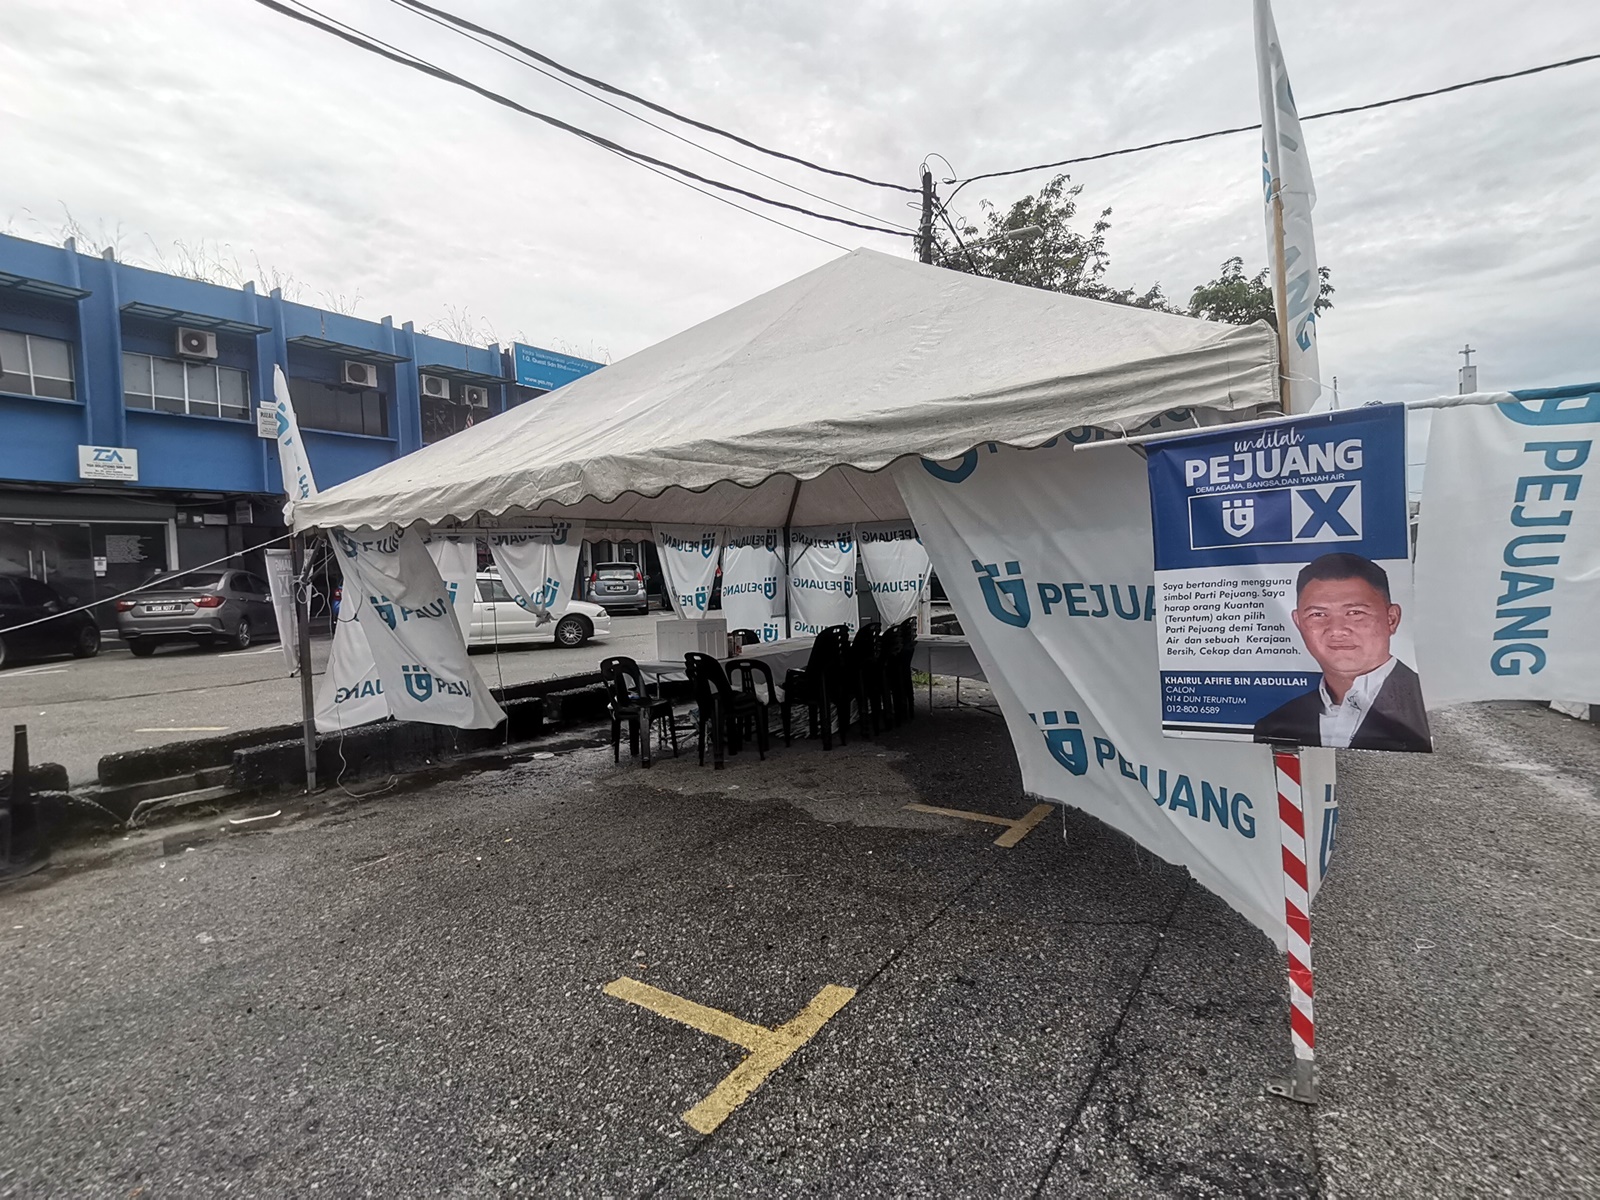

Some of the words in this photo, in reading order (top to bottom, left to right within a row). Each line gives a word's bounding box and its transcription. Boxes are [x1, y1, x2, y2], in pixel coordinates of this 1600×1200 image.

[1234, 427, 1305, 453] undilah
[1185, 439, 1363, 487] PEJUANG
[1195, 486, 1215, 494] DEMI
[1214, 483, 1246, 493] AGAMA,
[1300, 474, 1329, 484] TANAH
[1330, 472, 1346, 482] AIR
[1490, 440, 1593, 677] PEJUANG
[1163, 582, 1184, 592] Saya
[1186, 579, 1239, 590] bertanding
[1241, 578, 1292, 588] mengguna
[1164, 592, 1192, 602] simbol
[1195, 590, 1217, 600] Parti
[1219, 590, 1260, 600] Pejuang.
[1262, 589, 1286, 600] Saya
[1164, 604, 1191, 613] harap
[1193, 603, 1221, 612] orang
[1224, 601, 1265, 610] Kuantan
[1165, 613, 1214, 625] (Teruntum)
[1216, 613, 1241, 622] akan
[1244, 612, 1266, 622] pilih
[1166, 625, 1186, 634] Parti
[1188, 624, 1226, 635] Pejuang
[1229, 624, 1254, 632] demi
[1257, 623, 1286, 632] Tanah
[1166, 636, 1180, 645] Air
[1184, 636, 1202, 644] dan
[1205, 635, 1240, 644] sebuah
[1246, 634, 1292, 645] Kerajaan
[1167, 648, 1197, 656] Bersih,
[1200, 647, 1230, 657] Cekap
[1233, 647, 1253, 655] dan
[1255, 646, 1302, 656] Amanah.
[1165, 676, 1202, 685] KHAIRUL
[1204, 677, 1232, 686] AFIFIE
[1234, 678, 1251, 686] BIN
[1254, 678, 1308, 686] ABDULLAH
[1166, 686, 1196, 694] CALON
[1203, 696, 1247, 704] TERUNTUM
[1166, 705, 1198, 714] 012-800
[1200, 706, 1220, 714] 6589
